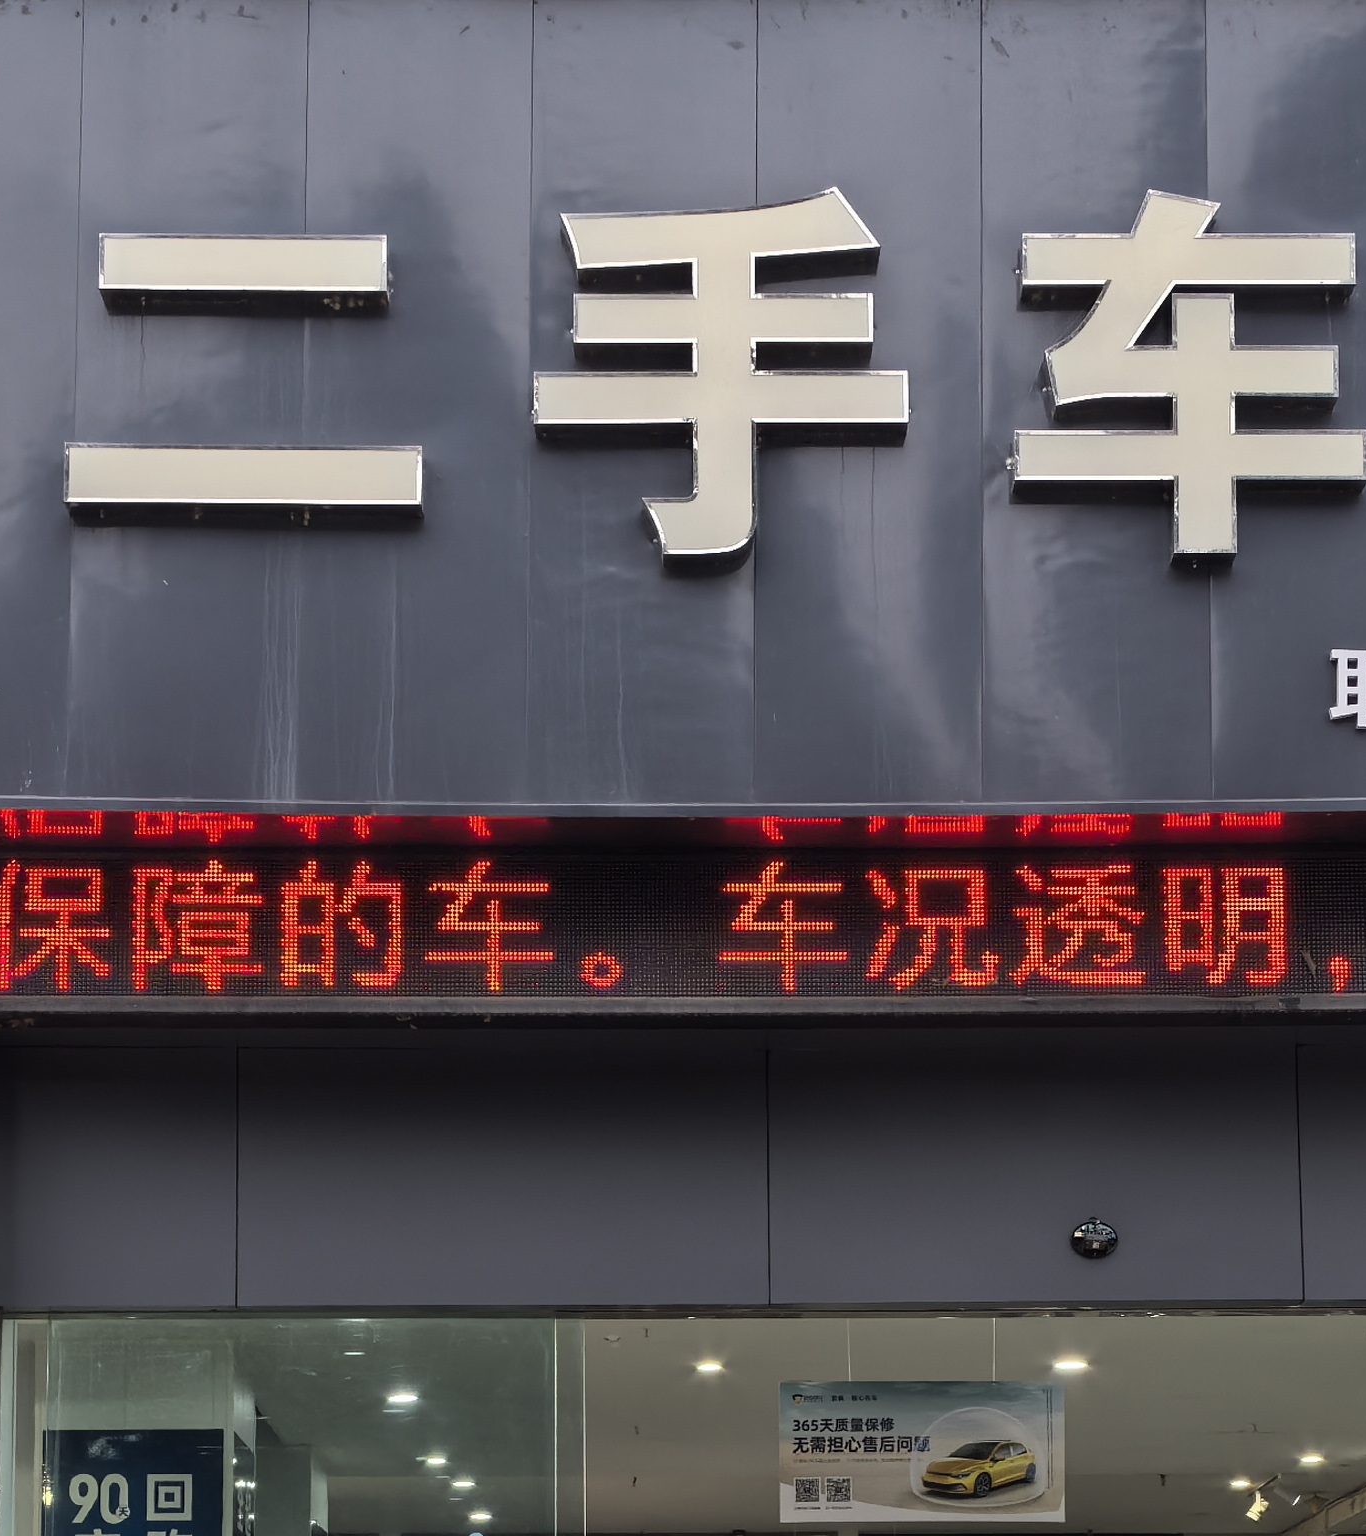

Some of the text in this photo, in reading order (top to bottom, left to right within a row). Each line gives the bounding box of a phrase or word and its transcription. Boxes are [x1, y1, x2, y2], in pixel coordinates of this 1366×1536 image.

[792, 1417, 895, 1433] 365天质量保修
[792, 1435, 931, 1454] 无需担心售后问题
